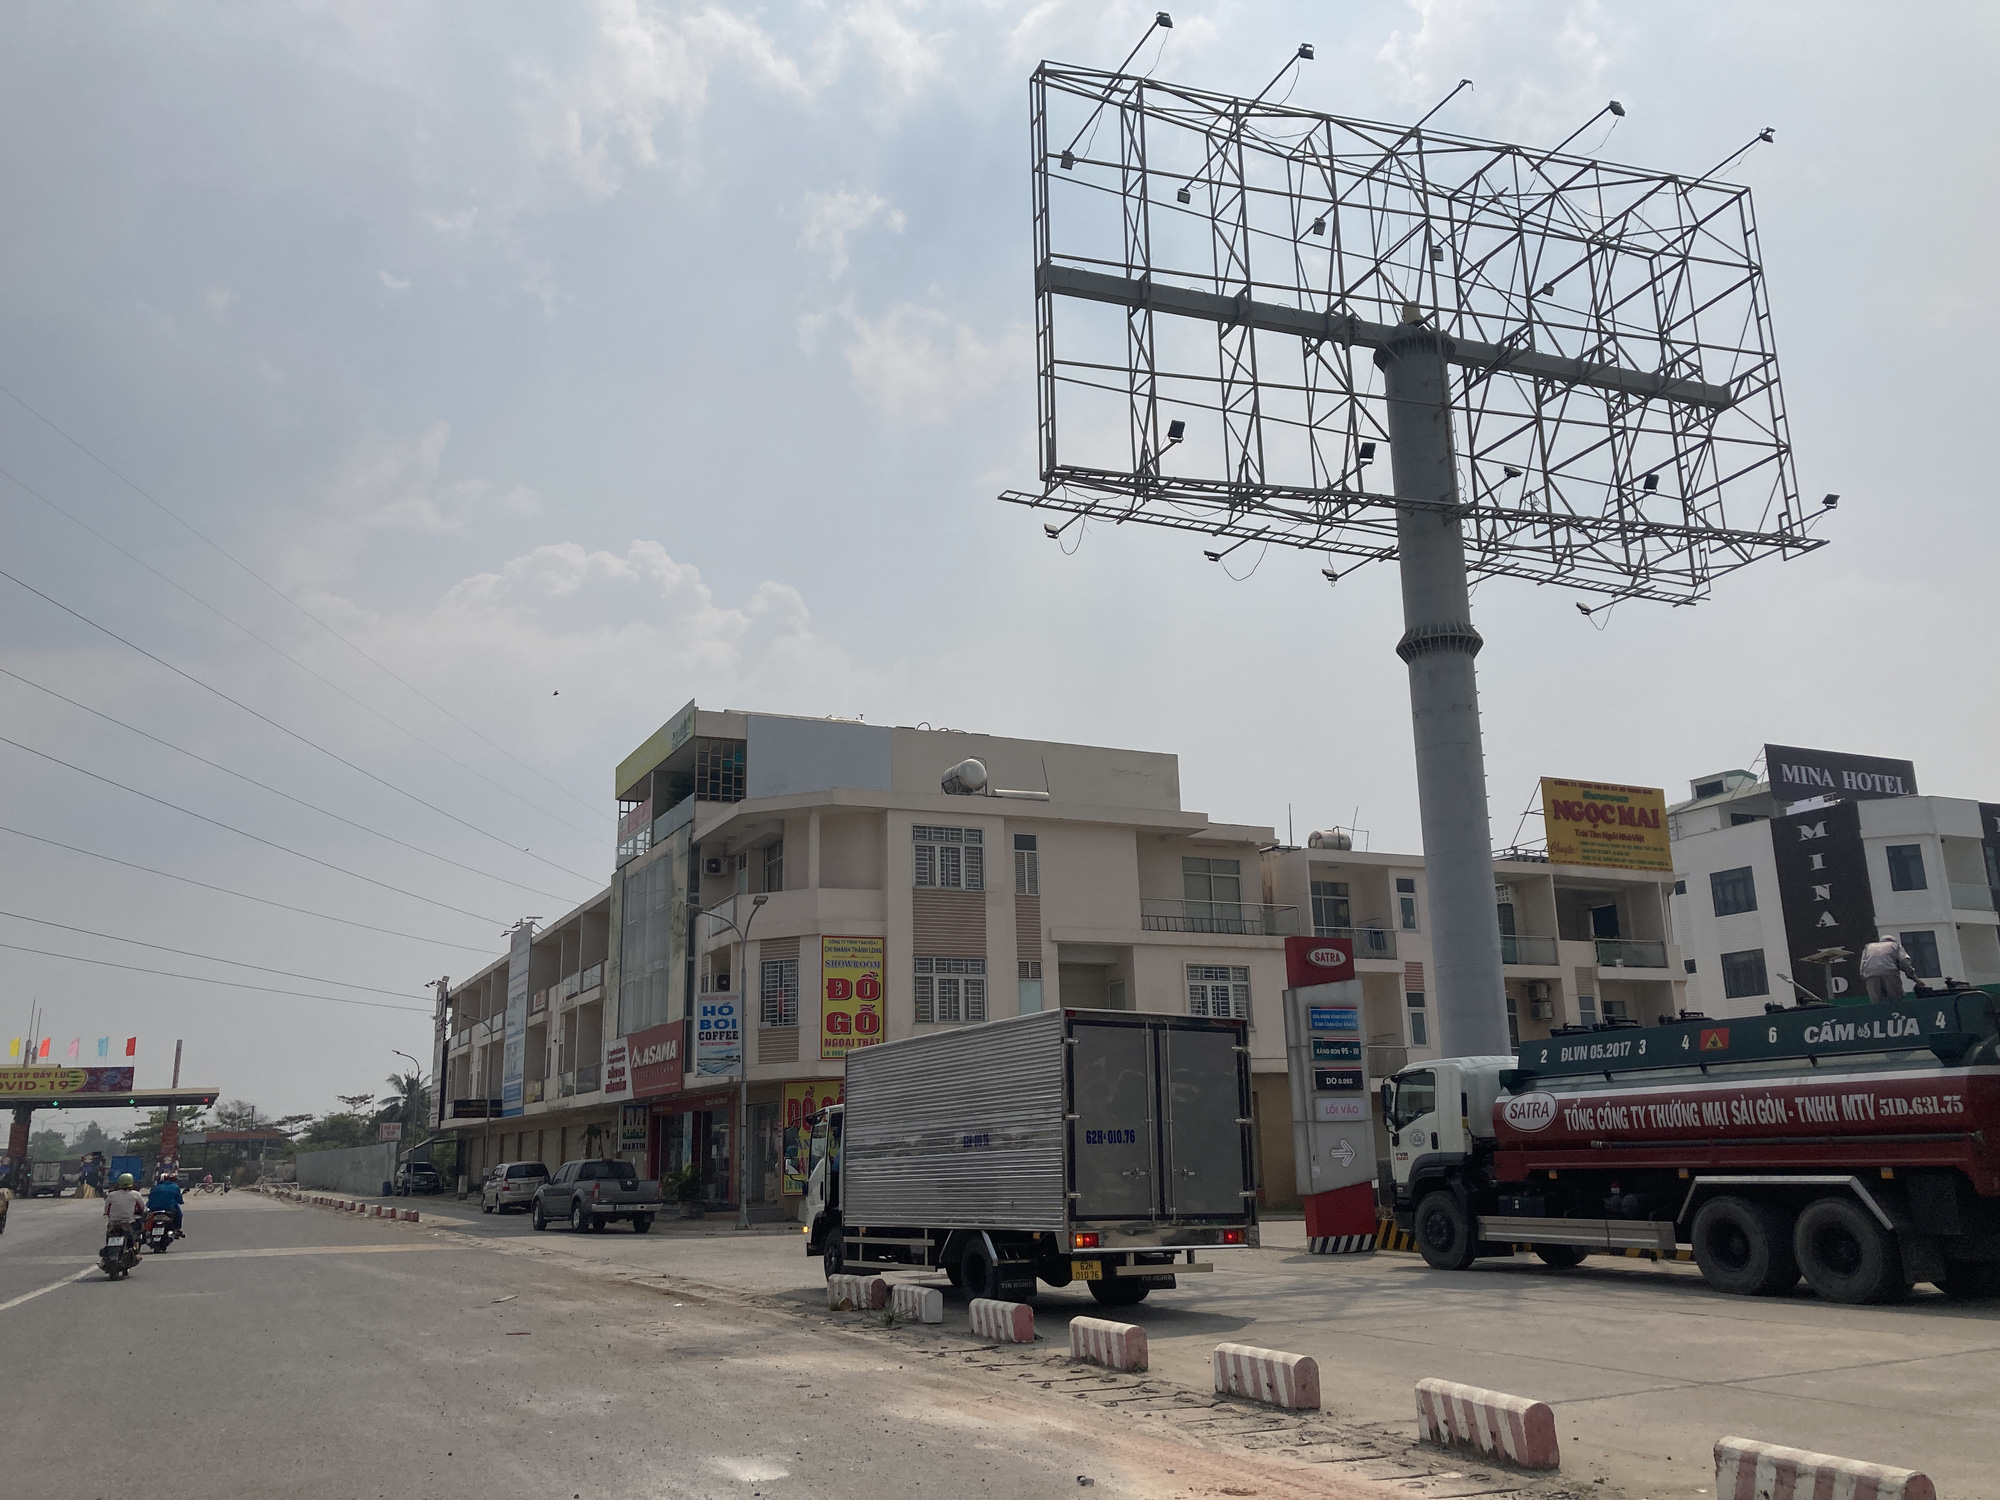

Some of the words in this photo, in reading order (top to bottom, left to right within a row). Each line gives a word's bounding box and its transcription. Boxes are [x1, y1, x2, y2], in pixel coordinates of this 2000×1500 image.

[1781, 763, 1836, 787] MINA
[1841, 770, 1909, 795] HOTEL
[1552, 799, 1615, 829] NGỌC
[1618, 805, 1661, 829] MAI
[1796, 820, 1839, 928] MINA
[825, 960, 881, 969] SHOWROOM
[1314, 952, 1341, 963] SATRA
[826, 971, 881, 1001] ĐỒ
[703, 1001, 734, 1017] HỒ
[826, 1003, 881, 1035] GỖ
[1935, 1011, 1946, 1029] 4
[698, 1030, 739, 1041] COFFEE
[1768, 1026, 1778, 1043] 6
[1804, 1018, 1855, 1044] CẤM
[1873, 1012, 1921, 1038] LỬA
[1341, 1047, 1349, 1055] 95
[1638, 1039, 1647, 1055] 3
[1681, 1035, 1690, 1050] 4
[643, 1040, 678, 1067] ASAMA
[1540, 1049, 1548, 1063] 2
[1561, 1045, 1589, 1062] ĐLVN
[1590, 1041, 1632, 1059] 05.2017
[1326, 1077, 1337, 1085] DO
[1325, 1102, 1338, 1114] LỐI
[1340, 1104, 1359, 1114] VÀO
[1509, 1101, 1550, 1119] SATRA
[1564, 1098, 1595, 1131] TỔNG
[1596, 1101, 1629, 1130] CÔNG
[1629, 1105, 1646, 1129] TY
[1702, 1102, 1729, 1129] MẠI
[1731, 1094, 1755, 1126] SÀI
[1755, 1092, 1788, 1125] GÒN
[1795, 1096, 1839, 1123] TNHH
[1841, 1093, 1877, 1121] MTV
[1879, 1094, 1964, 1116] 51D.631.75
[622, 1142, 646, 1150] MARTIN
[1080, 1262, 1093, 1270] 62H
